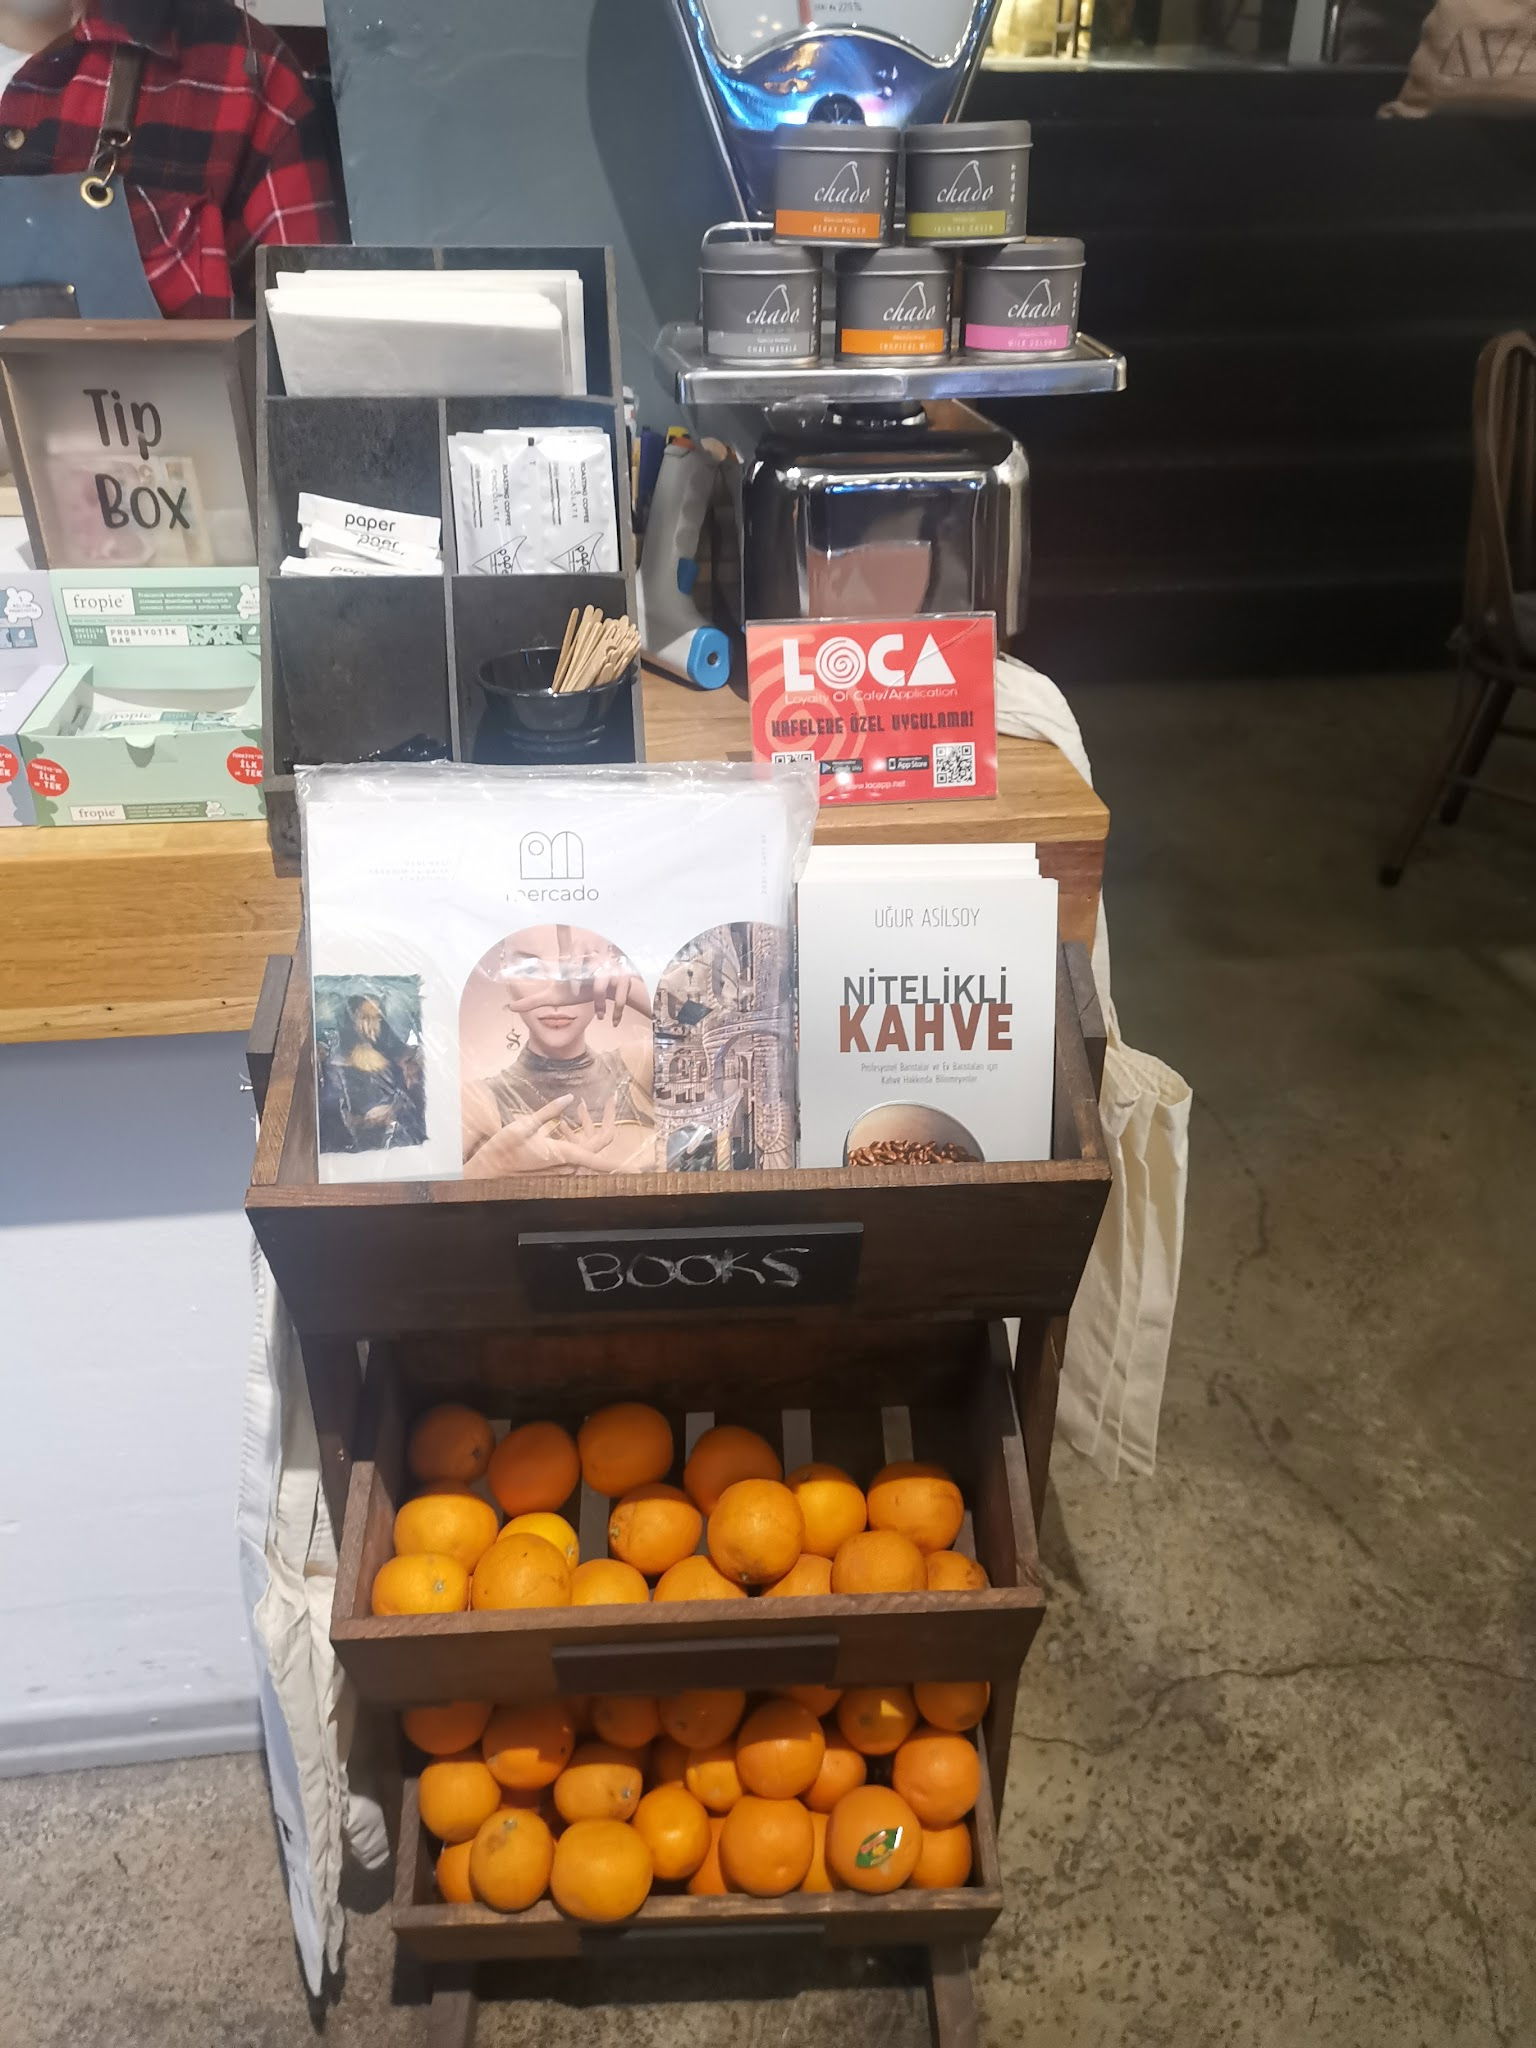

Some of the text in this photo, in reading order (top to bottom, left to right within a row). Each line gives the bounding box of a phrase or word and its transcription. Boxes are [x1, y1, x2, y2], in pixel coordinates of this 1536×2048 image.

[814, 161, 870, 203] chado
[937, 160, 994, 203] chado
[746, 284, 800, 325] chado
[883, 281, 936, 322] chado
[1008, 279, 1061, 318] chado
[83, 389, 162, 460] Tip
[345, 514, 396, 532] paper
[73, 593, 123, 612] fropie
[783, 633, 956, 691] LOCA
[784, 693, 829, 706] Loyalty
[850, 712, 885, 732] ÖZEL
[43, 781, 62, 791] TEK
[245, 768, 262, 778] TEK
[79, 807, 117, 820] fropie
[874, 905, 980, 928] UĞUR ASİLSOY
[844, 966, 1007, 1005] NİTELİKLİ
[840, 1004, 1013, 1053] KAHVE
[576, 1247, 810, 1292] BOOKS
